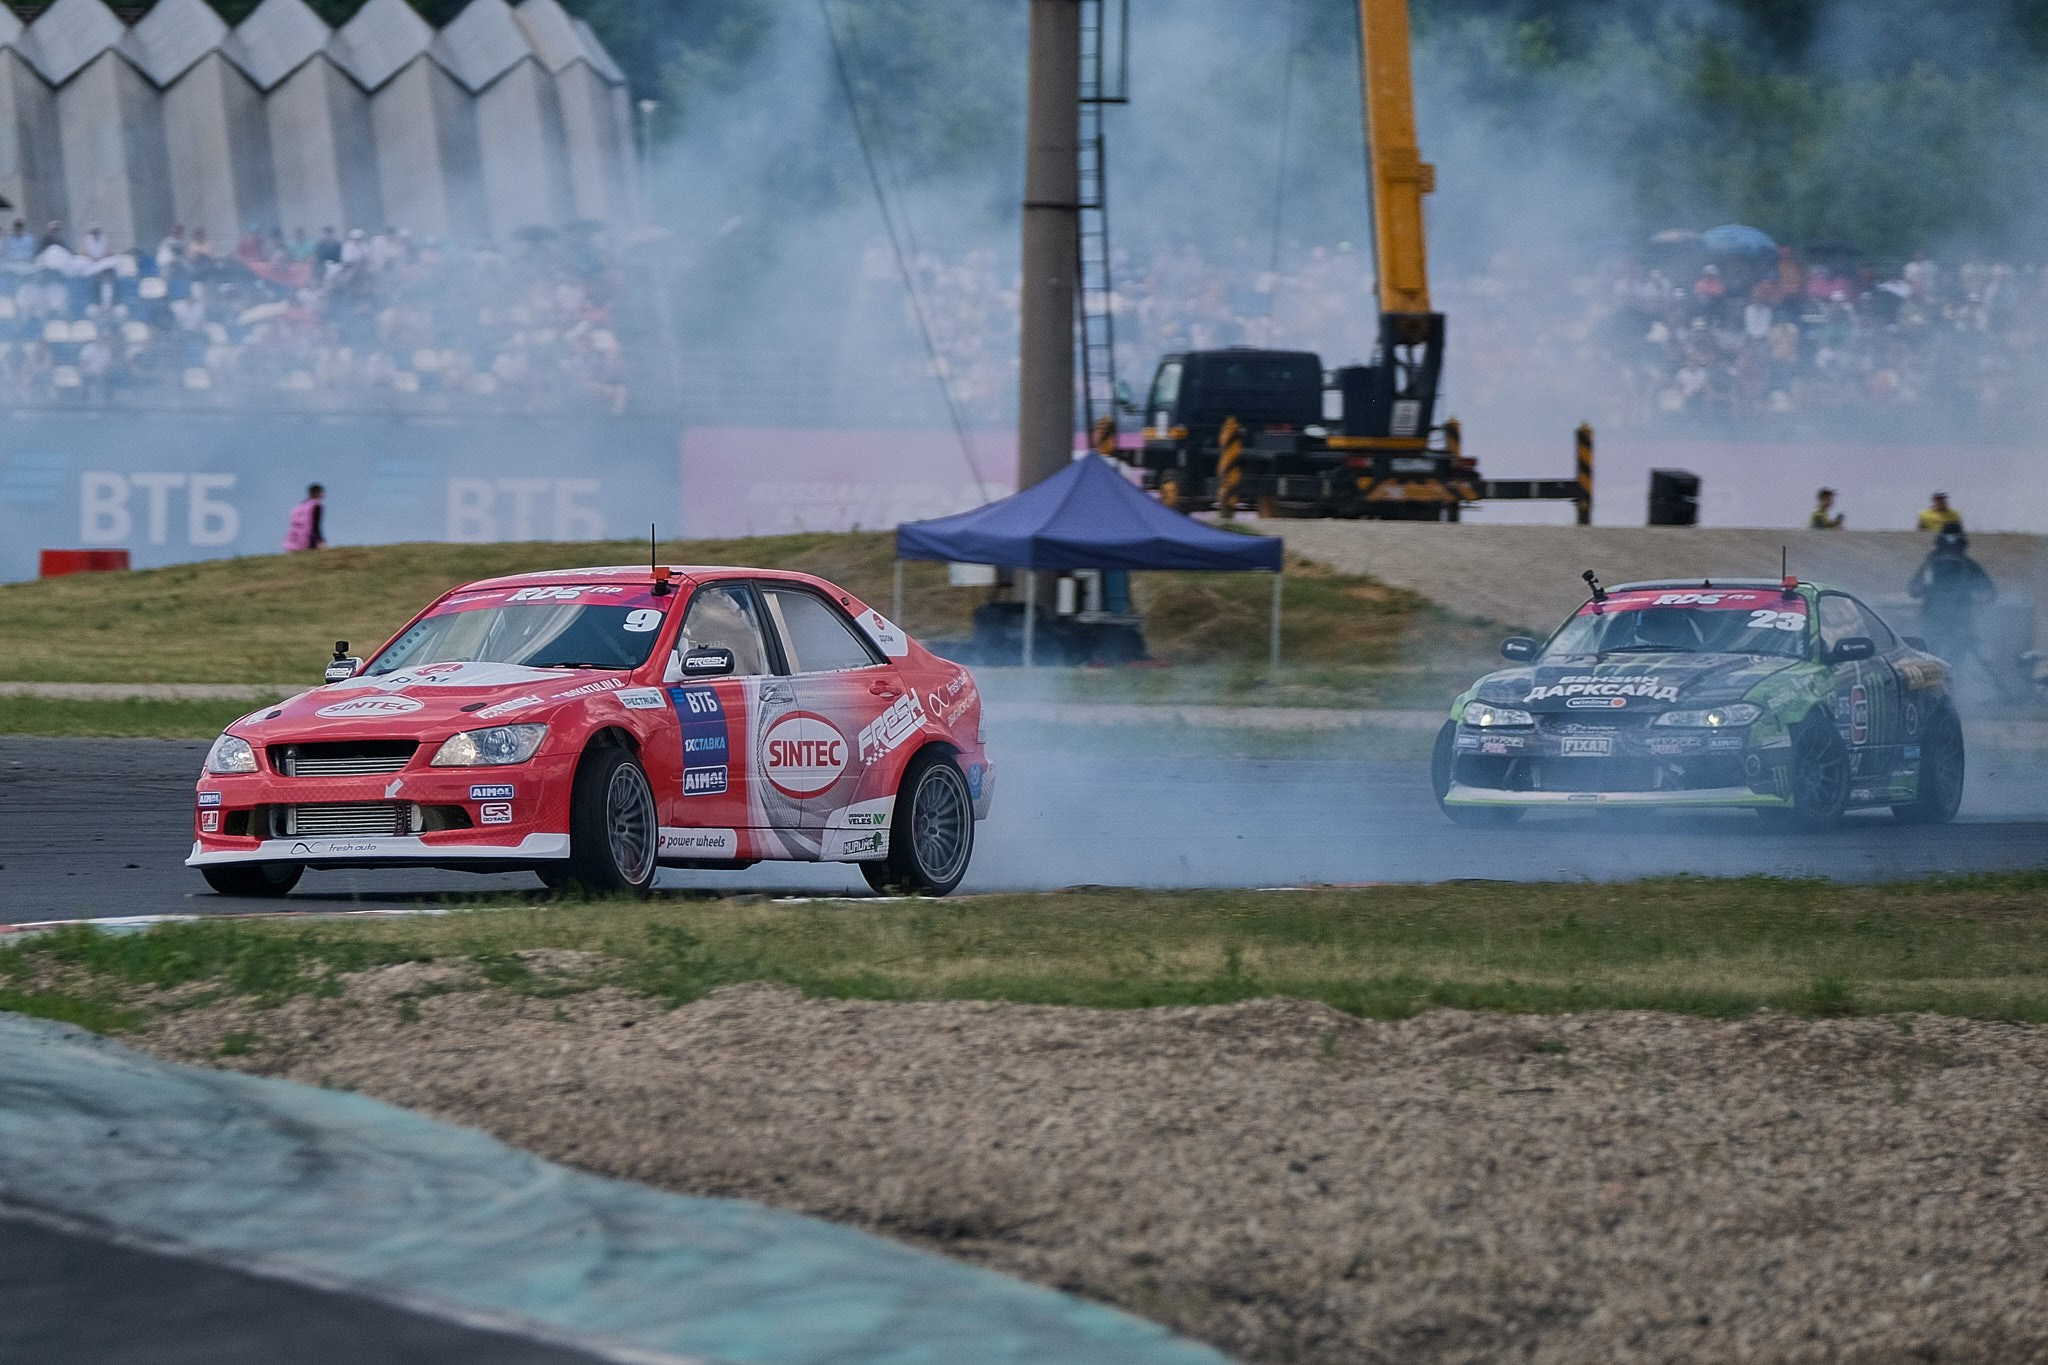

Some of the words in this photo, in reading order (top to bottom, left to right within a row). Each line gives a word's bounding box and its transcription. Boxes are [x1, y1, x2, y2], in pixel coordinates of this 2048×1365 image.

[81, 471, 240, 545] ВТБ
[446, 475, 606, 541] ВТБ
[505, 586, 592, 602] RDS
[1652, 594, 1726, 605] RDS
[622, 608, 662, 632] 9
[1747, 609, 1806, 631] 23
[686, 656, 728, 668] FRESH
[686, 691, 718, 713] ВТБ
[1522, 684, 1679, 703] ДАРКСАЙД
[325, 701, 417, 713] SINTEC
[858, 687, 928, 762] FRESH
[769, 740, 841, 767] SINTEC
[1565, 740, 1608, 753] FIXAR
[685, 770, 725, 790] AIMOL
[472, 787, 511, 797] AIMOL
[328, 843, 352, 852] fresh
[354, 843, 377, 851] auto
[667, 836, 695, 848] power
[696, 834, 726, 847] wheels
